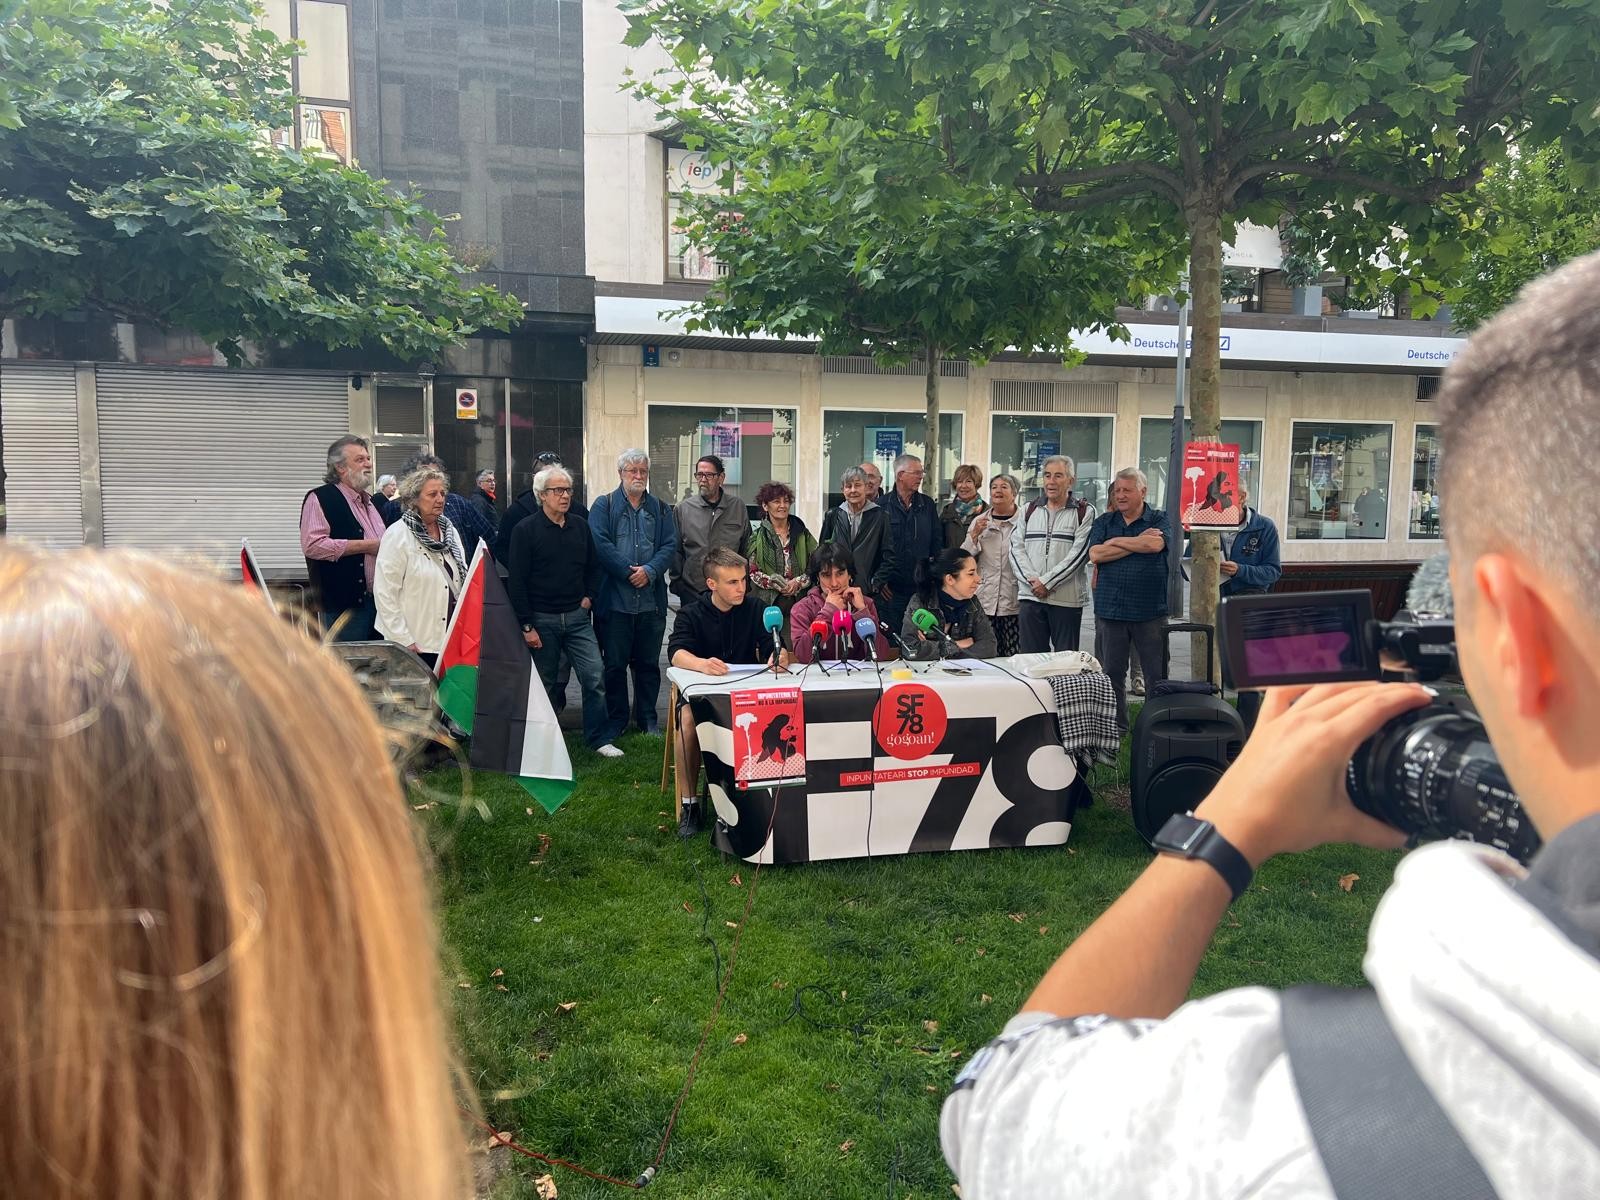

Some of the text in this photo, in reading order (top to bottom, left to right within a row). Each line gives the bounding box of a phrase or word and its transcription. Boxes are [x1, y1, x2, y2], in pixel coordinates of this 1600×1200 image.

[687, 162, 712, 180] iep
[1407, 349, 1450, 360] Deutsche
[896, 693, 925, 714] SF
[896, 712, 924, 735] 78
[886, 731, 935, 748] gogoan!
[846, 766, 974, 783] INPUNTATEARI STOP IMPUNIDAD
